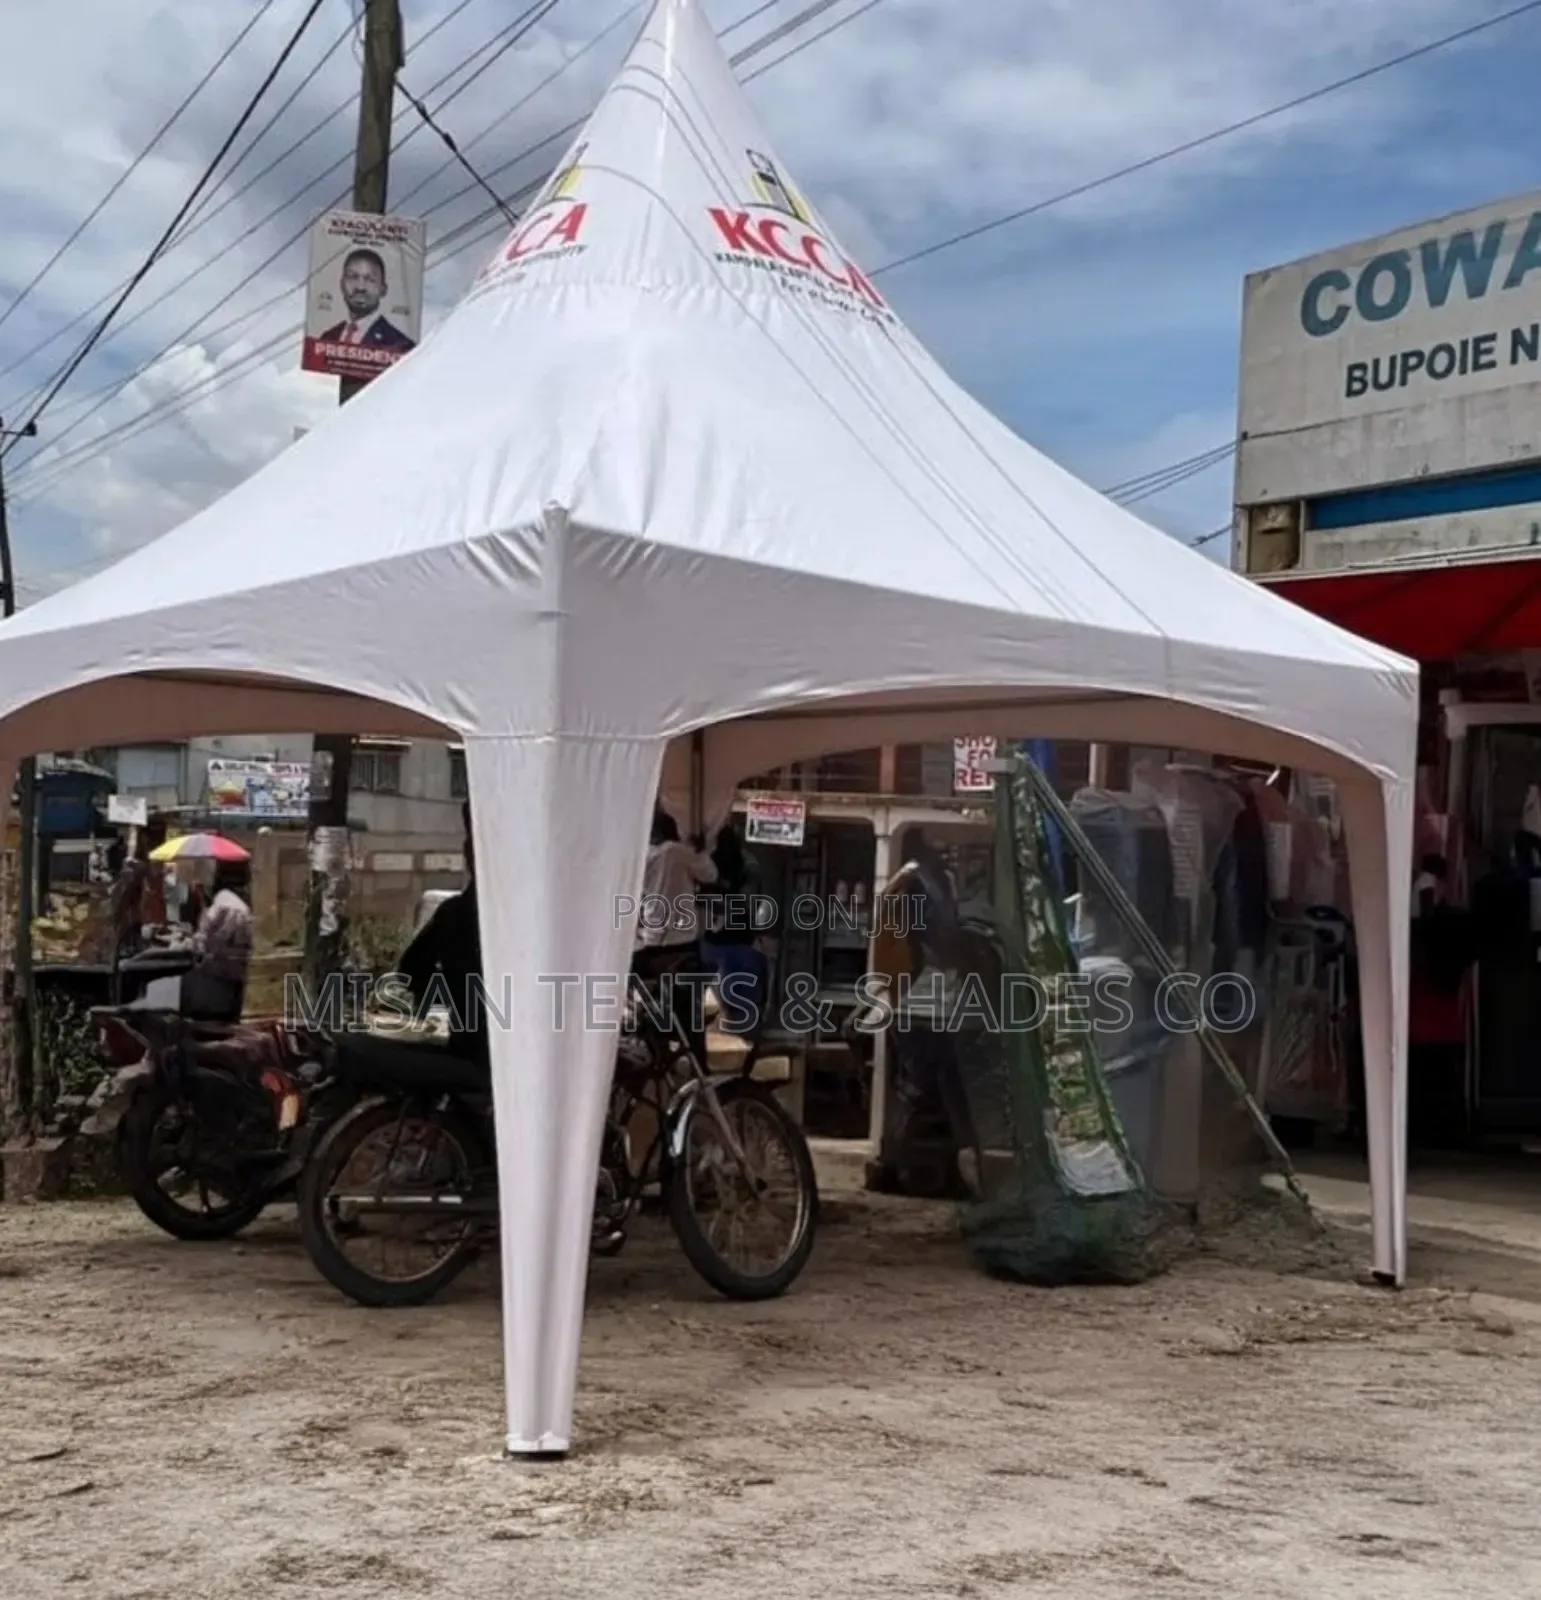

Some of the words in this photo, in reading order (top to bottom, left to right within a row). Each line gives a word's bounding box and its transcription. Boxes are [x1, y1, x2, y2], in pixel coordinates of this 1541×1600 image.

[707, 208, 885, 309] KCCA
[314, 342, 402, 364] PRESIDEN
[1345, 333, 1497, 398] BUPOIE
[954, 735, 995, 748] SHO
[956, 768, 991, 787] RE
